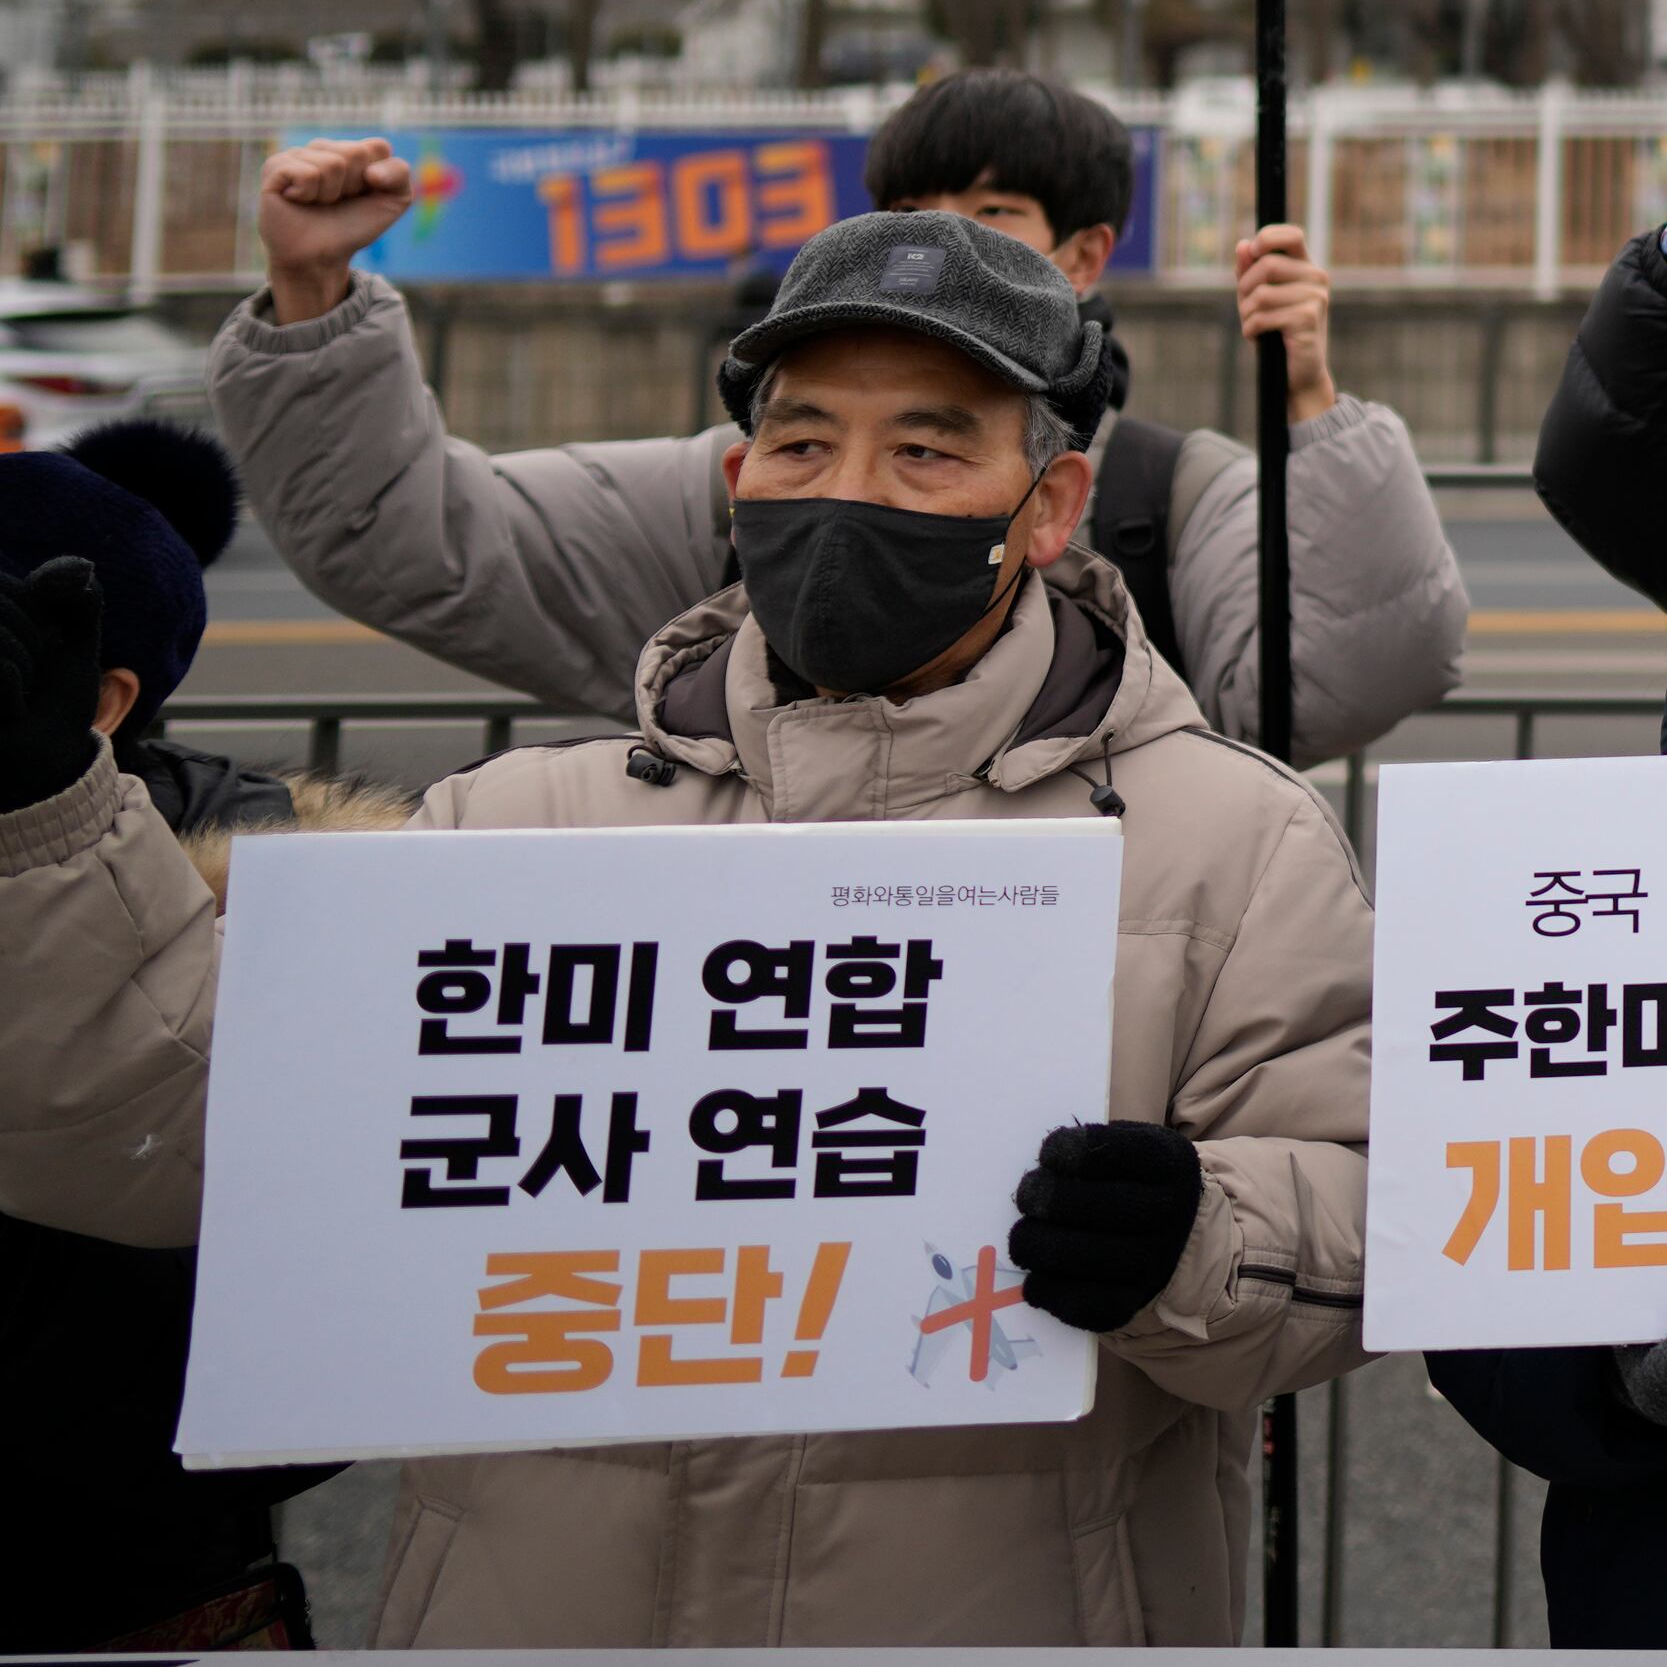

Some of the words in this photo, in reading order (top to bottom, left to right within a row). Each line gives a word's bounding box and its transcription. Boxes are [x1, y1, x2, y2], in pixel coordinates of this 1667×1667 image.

[537, 140, 834, 276] 1303
[831, 885, 1059, 907] 평화와통일을여는사람들
[1526, 869, 1648, 937] 중국
[416, 939, 658, 1055] 한미
[702, 936, 943, 1051] 연합
[400, 1092, 650, 1209] 군사
[689, 1087, 926, 1201] 연습
[473, 1242, 851, 1395] 중단!
